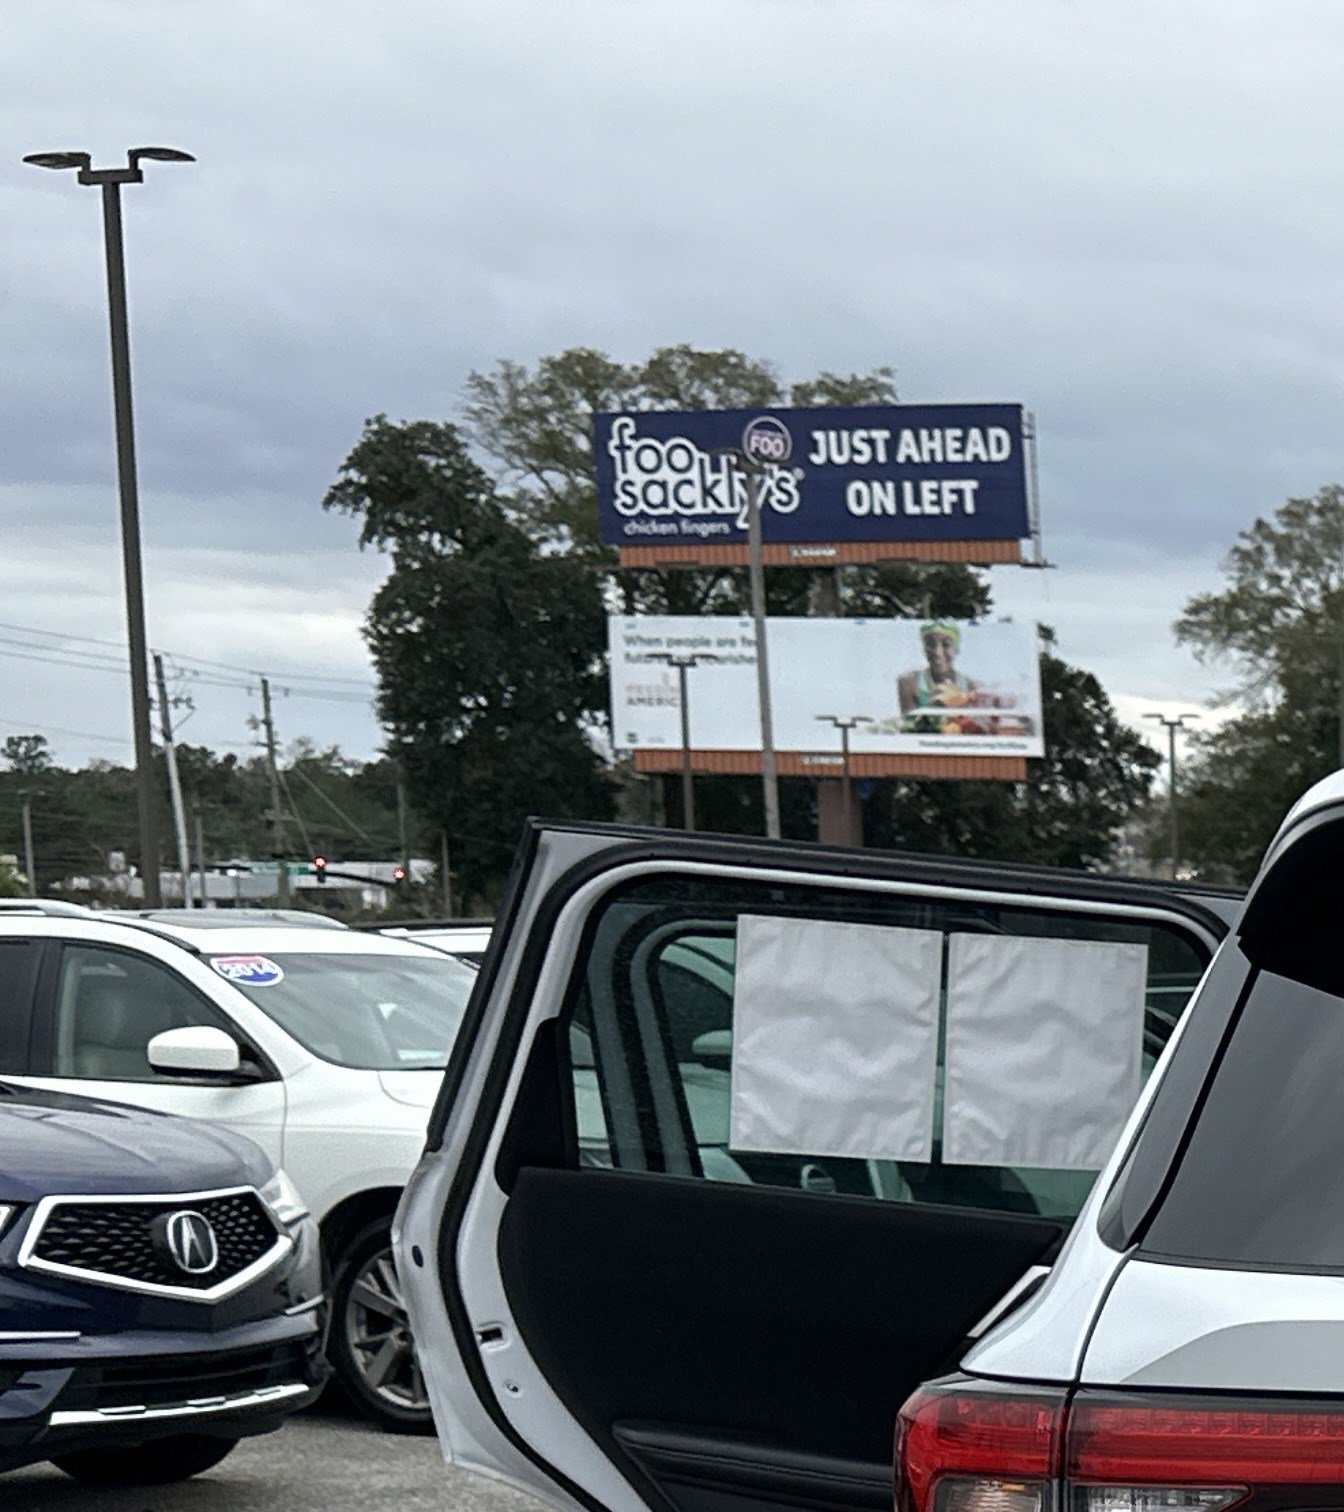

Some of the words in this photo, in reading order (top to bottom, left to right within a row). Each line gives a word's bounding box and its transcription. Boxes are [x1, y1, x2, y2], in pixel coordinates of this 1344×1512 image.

[610, 417, 696, 475] foo
[808, 429, 891, 465] JUST
[896, 427, 1012, 464] AHEAD
[846, 479, 898, 517] ON
[902, 479, 980, 516] LEFT
[624, 519, 679, 535] chicken
[680, 518, 732, 537] fingers
[665, 635, 712, 648] people
